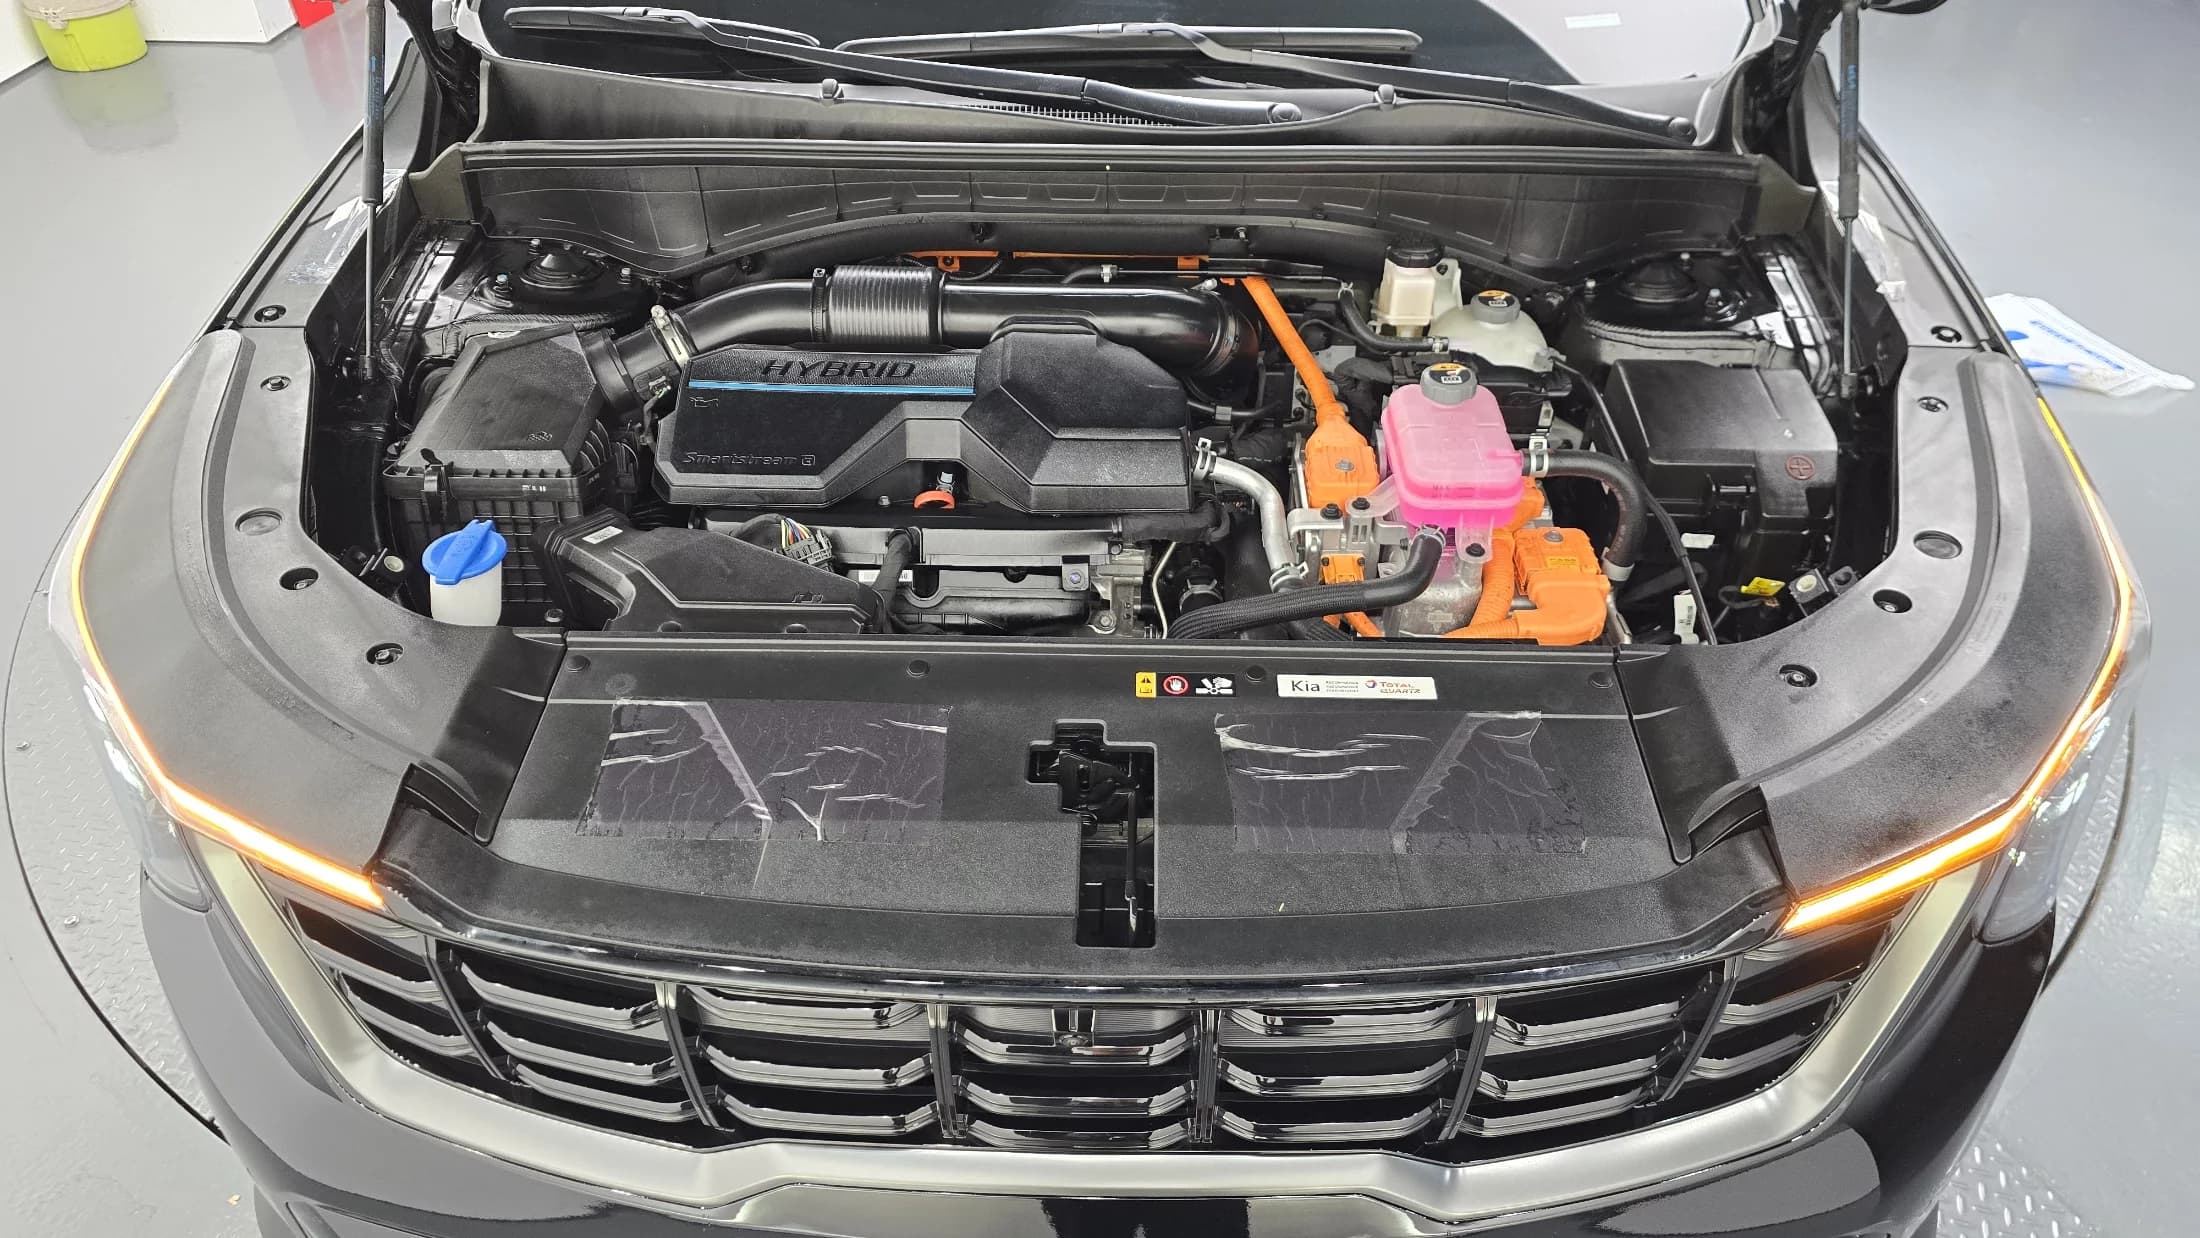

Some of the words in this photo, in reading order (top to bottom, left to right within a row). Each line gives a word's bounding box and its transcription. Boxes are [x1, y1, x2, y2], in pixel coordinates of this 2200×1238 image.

[760, 359, 916, 378] HYBRID
[682, 451, 798, 465] Smartstream
[1291, 679, 1320, 692] Kia
